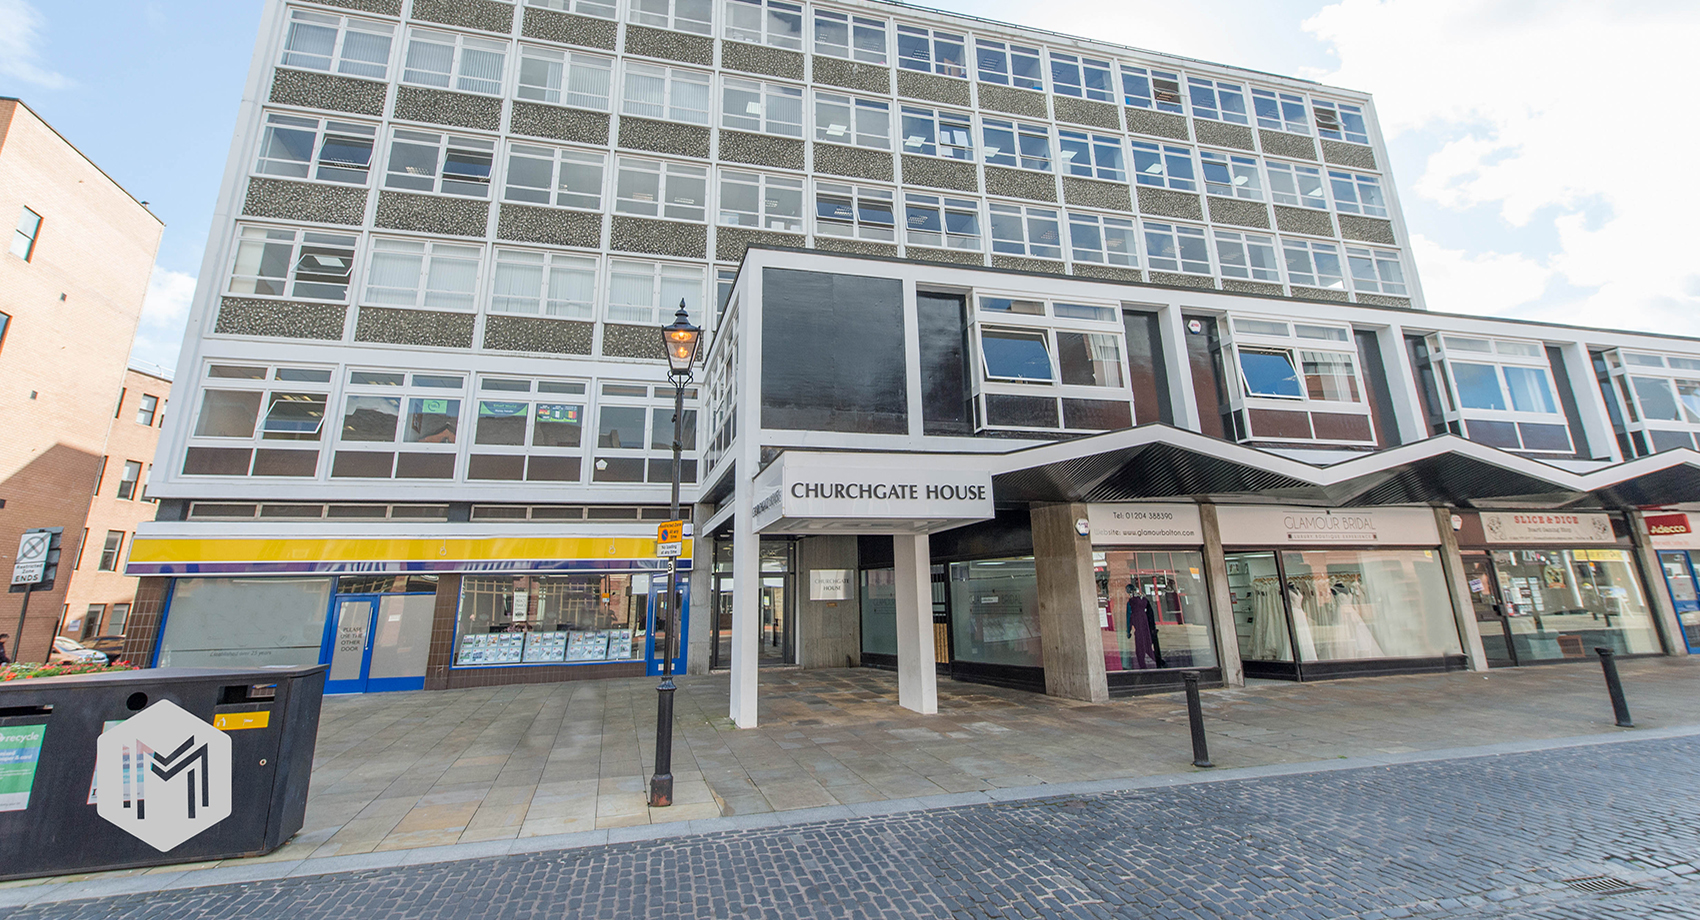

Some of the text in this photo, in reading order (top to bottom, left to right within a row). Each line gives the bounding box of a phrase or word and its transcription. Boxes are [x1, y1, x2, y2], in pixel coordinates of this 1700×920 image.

[791, 482, 986, 500] CHURCHGATE HOUSE
[1284, 516, 1376, 530] GLAMOUR BRIDAL
[1514, 516, 1545, 524] SLICE
[1554, 516, 1579, 524] DICE
[1651, 524, 1686, 534] Adecco
[15, 574, 38, 582] ENDS
[6, 732, 40, 743] recycle
